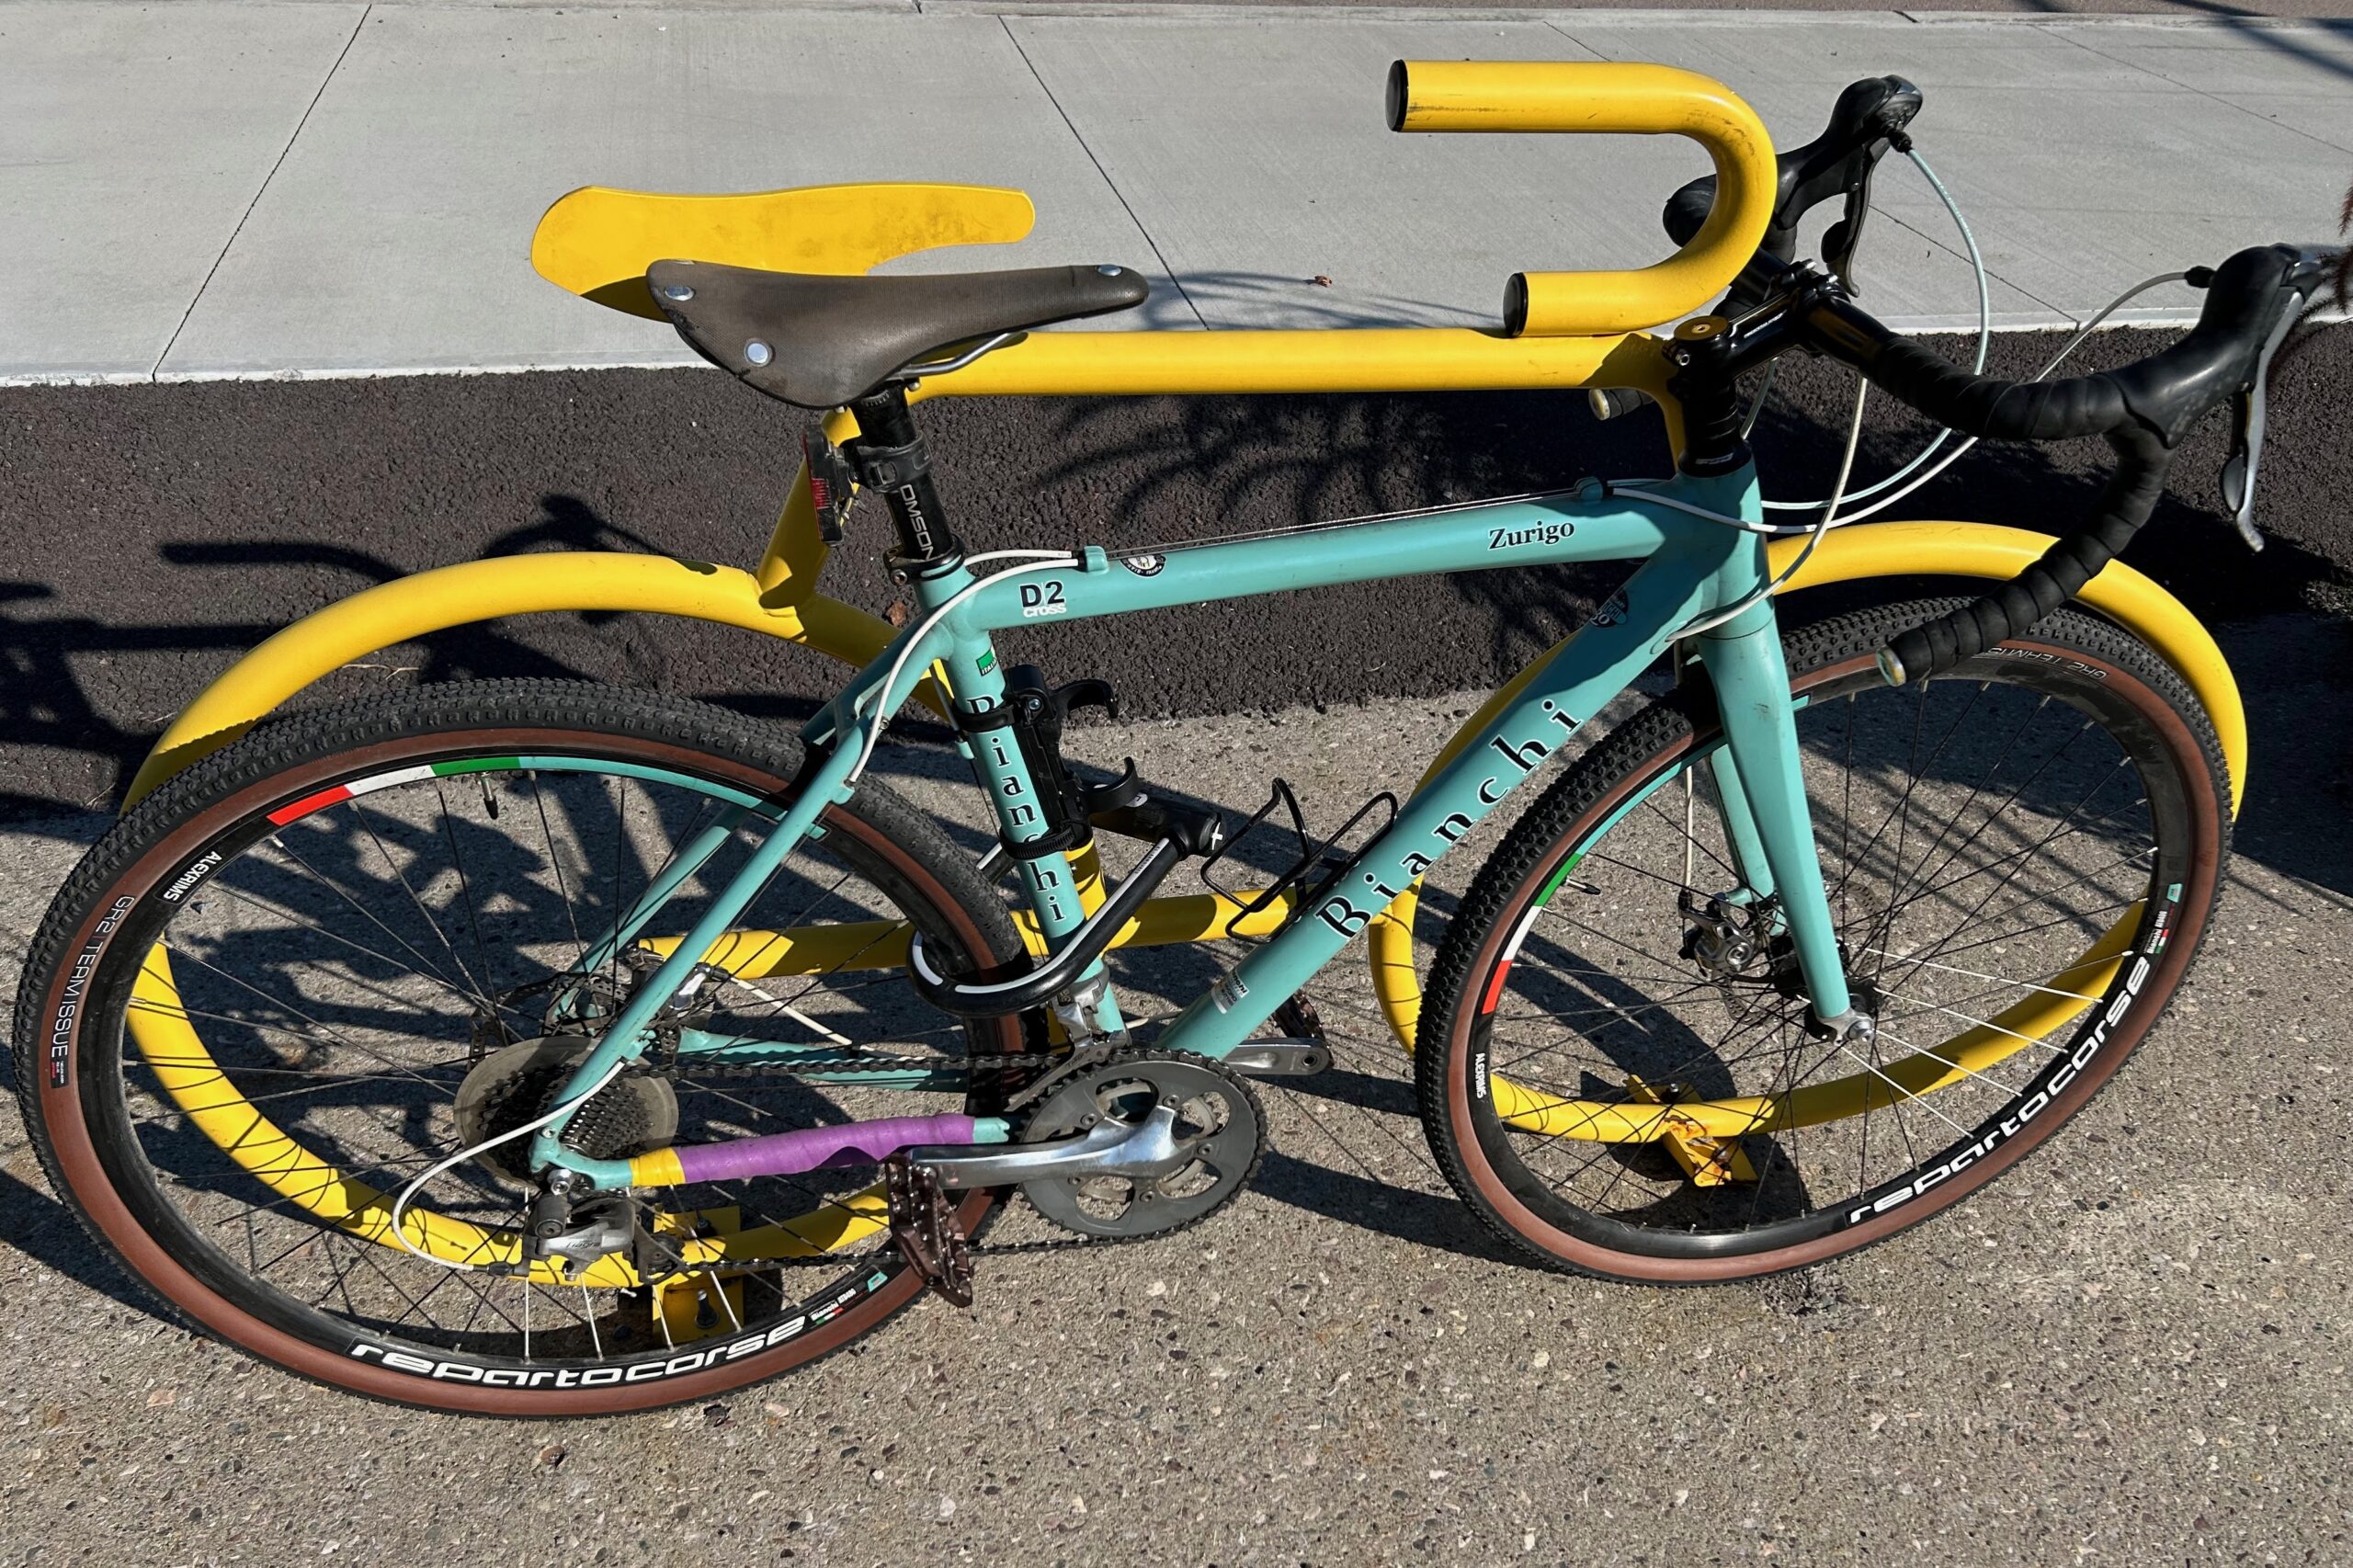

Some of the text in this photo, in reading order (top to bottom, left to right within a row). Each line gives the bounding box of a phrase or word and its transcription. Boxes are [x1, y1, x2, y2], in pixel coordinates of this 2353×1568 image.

[1487, 520, 1575, 550] Zurigo
[1022, 603, 1067, 618] cross
[2006, 648, 2063, 665] TEAM
[2066, 661, 2109, 680] GR2
[966, 695, 1065, 922] Bianhi
[1314, 699, 1585, 939] Bianchi
[163, 850, 223, 903] ALEXRIMS
[51, 895, 137, 1058] GR2 TEAM ISSUE
[1474, 1052, 1487, 1099] ALEXRIMS
